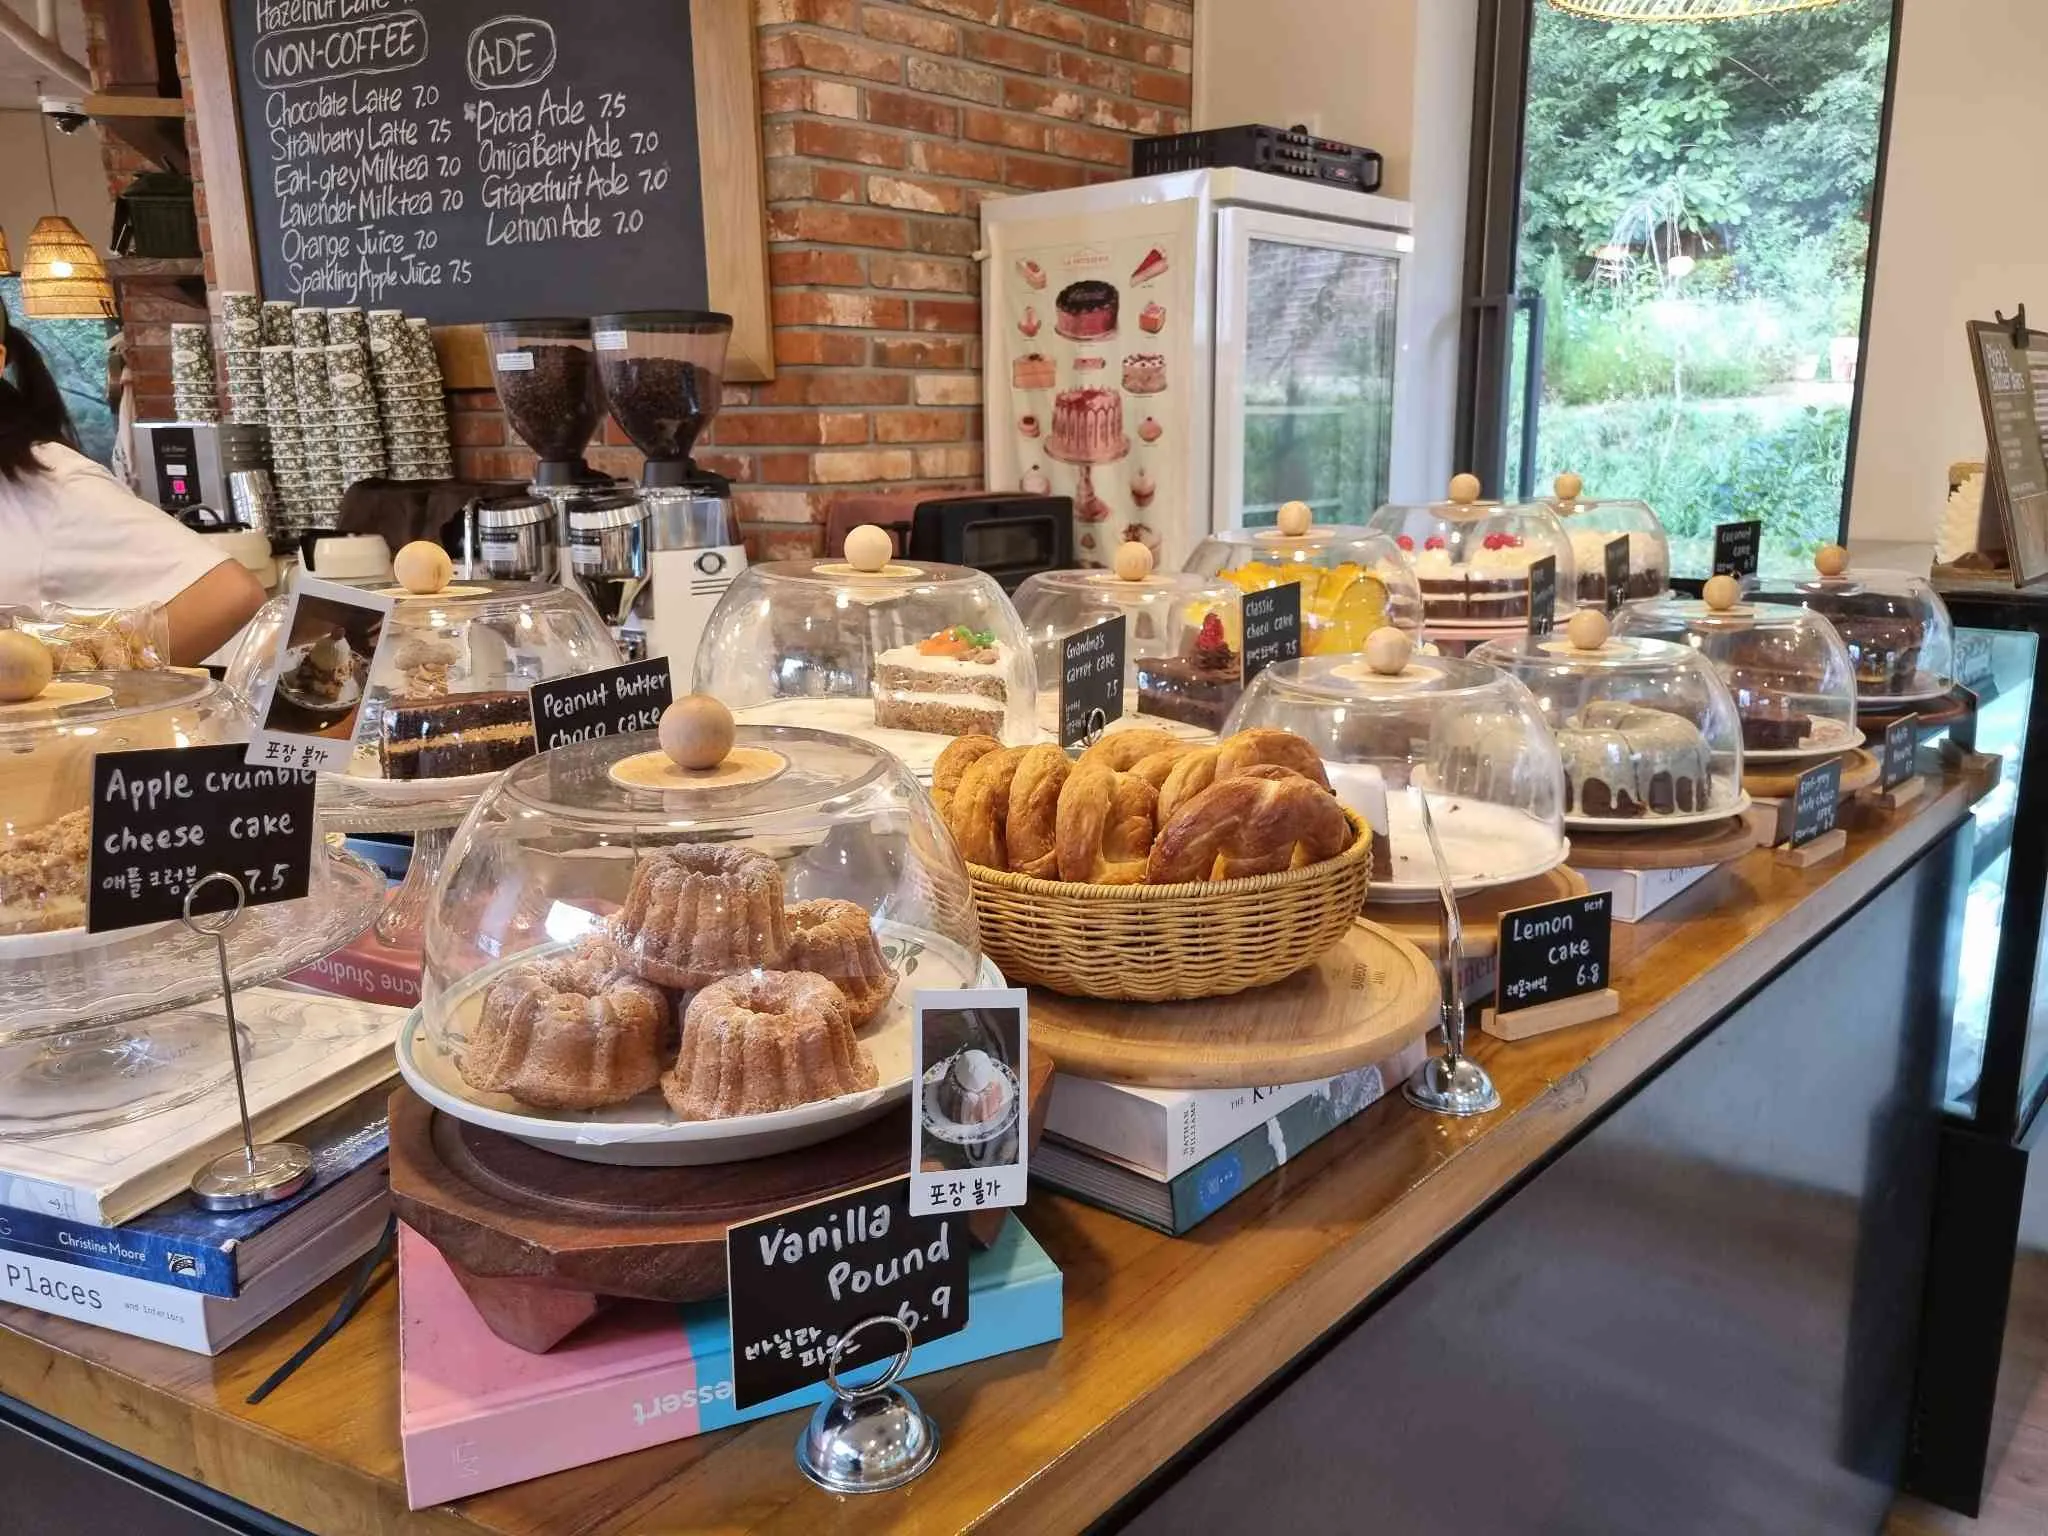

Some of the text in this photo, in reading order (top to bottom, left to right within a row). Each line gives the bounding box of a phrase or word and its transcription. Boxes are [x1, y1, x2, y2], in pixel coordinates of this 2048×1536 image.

[264, 18, 418, 78] NON-COFFEE
[477, 32, 535, 79] ADE
[265, 79, 440, 128] Chocolate Latte 7.0
[538, 86, 585, 127] Ade
[599, 92, 627, 119] 7.5
[270, 115, 452, 161] Strawberry Latte 7.5
[585, 120, 623, 162] Ade
[630, 131, 659, 154] 7.0
[274, 150, 462, 200] Earl-grey Milktea 7.0
[482, 162, 668, 214] Grapefruit Ade 7.0
[280, 193, 357, 229] Lavender
[440, 189, 464, 212] 7.0
[486, 202, 643, 246] Lemon Ade 7.0
[281, 224, 438, 268] Orange Juice 7.0
[287, 253, 472, 306] Sparkling Apple Juice 7.5
[1096, 651, 1115, 672] cake
[543, 672, 669, 720] Peanut Butter
[618, 706, 661, 735] cake
[264, 740, 329, 768] 포장 불가
[106, 767, 314, 812] Apple crumble
[104, 813, 295, 854] cheese cake
[244, 863, 290, 895] 7.5
[1513, 914, 1573, 941] Lemon
[930, 1178, 1002, 1207] 포장 불가
[58, 1231, 147, 1262] Christine Moore
[760, 1203, 891, 1266] Vanilla
[828, 1221, 950, 1301] Pound
[6, 1264, 103, 1310] Places
[897, 1285, 951, 1332] 6.9
[745, 1326, 823, 1361] 바닐라
[632, 1380, 733, 1426] essert
